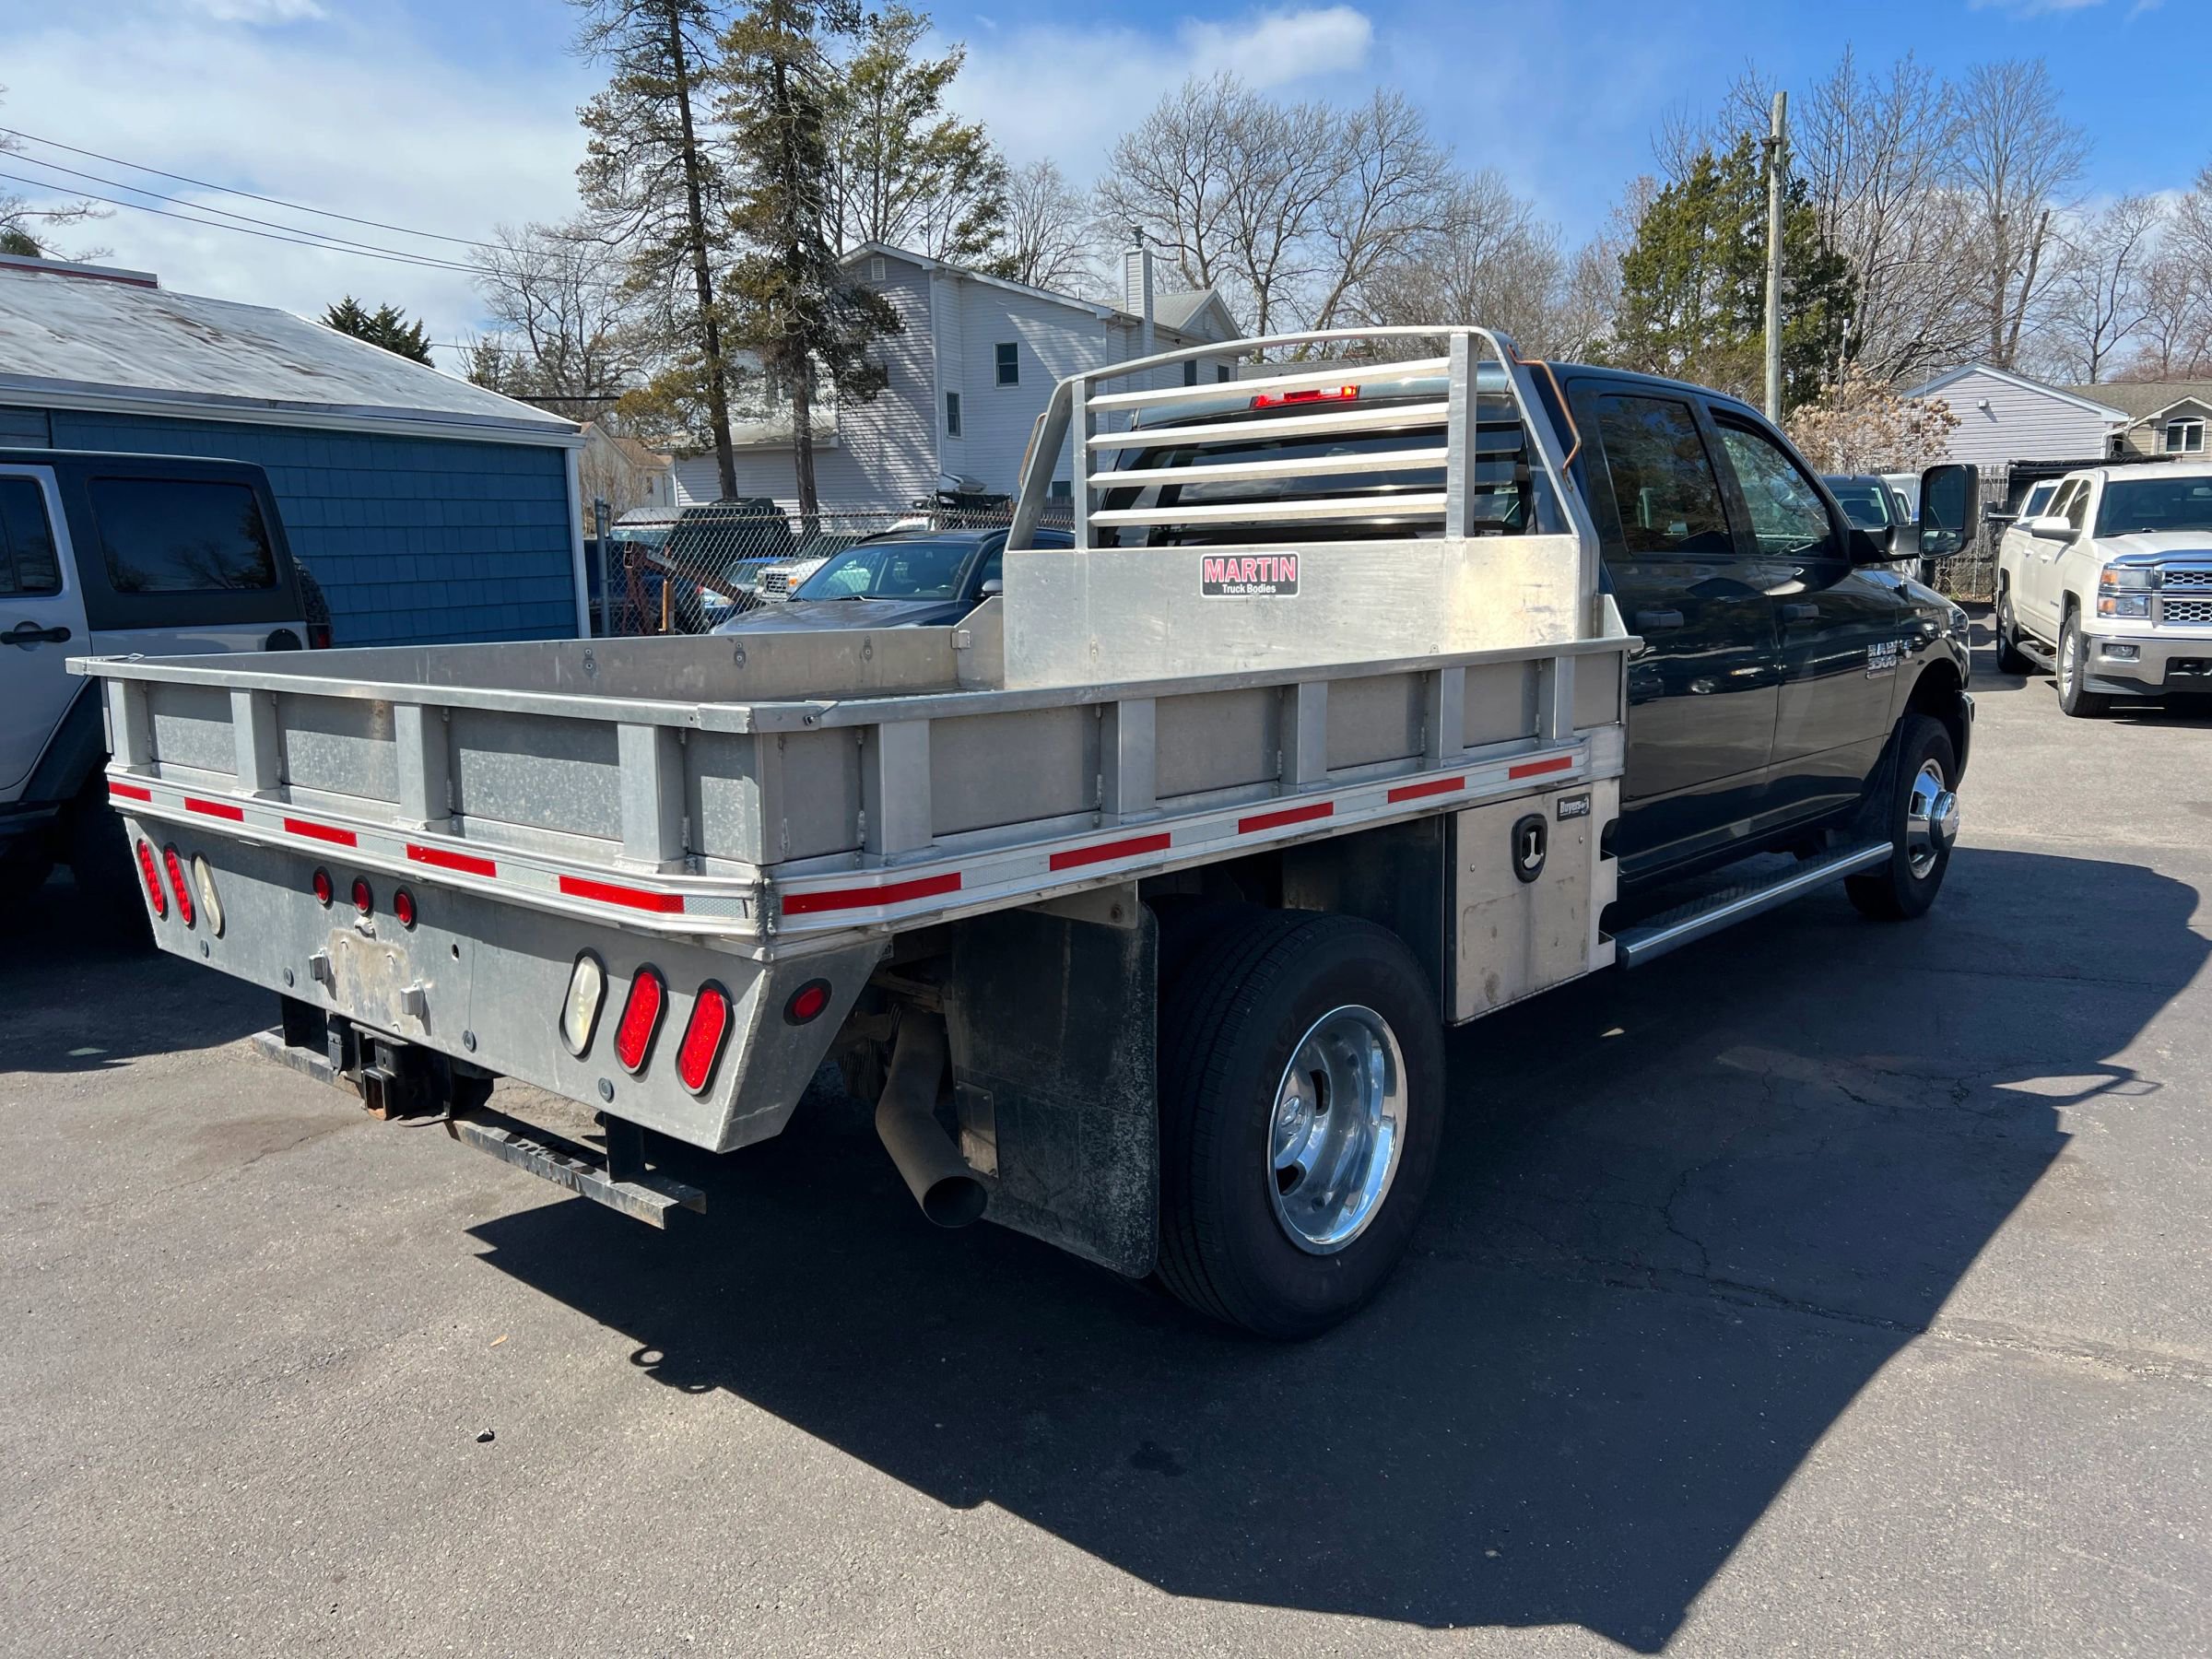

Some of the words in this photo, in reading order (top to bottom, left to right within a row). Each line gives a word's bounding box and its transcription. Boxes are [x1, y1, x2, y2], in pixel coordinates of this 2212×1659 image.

[1204, 557, 1296, 582] MARTIN
[1222, 583, 1246, 594] Truck
[1246, 583, 1277, 594] Bodies
[1867, 641, 1897, 657] RAM
[1559, 801, 1582, 815] Buyers
